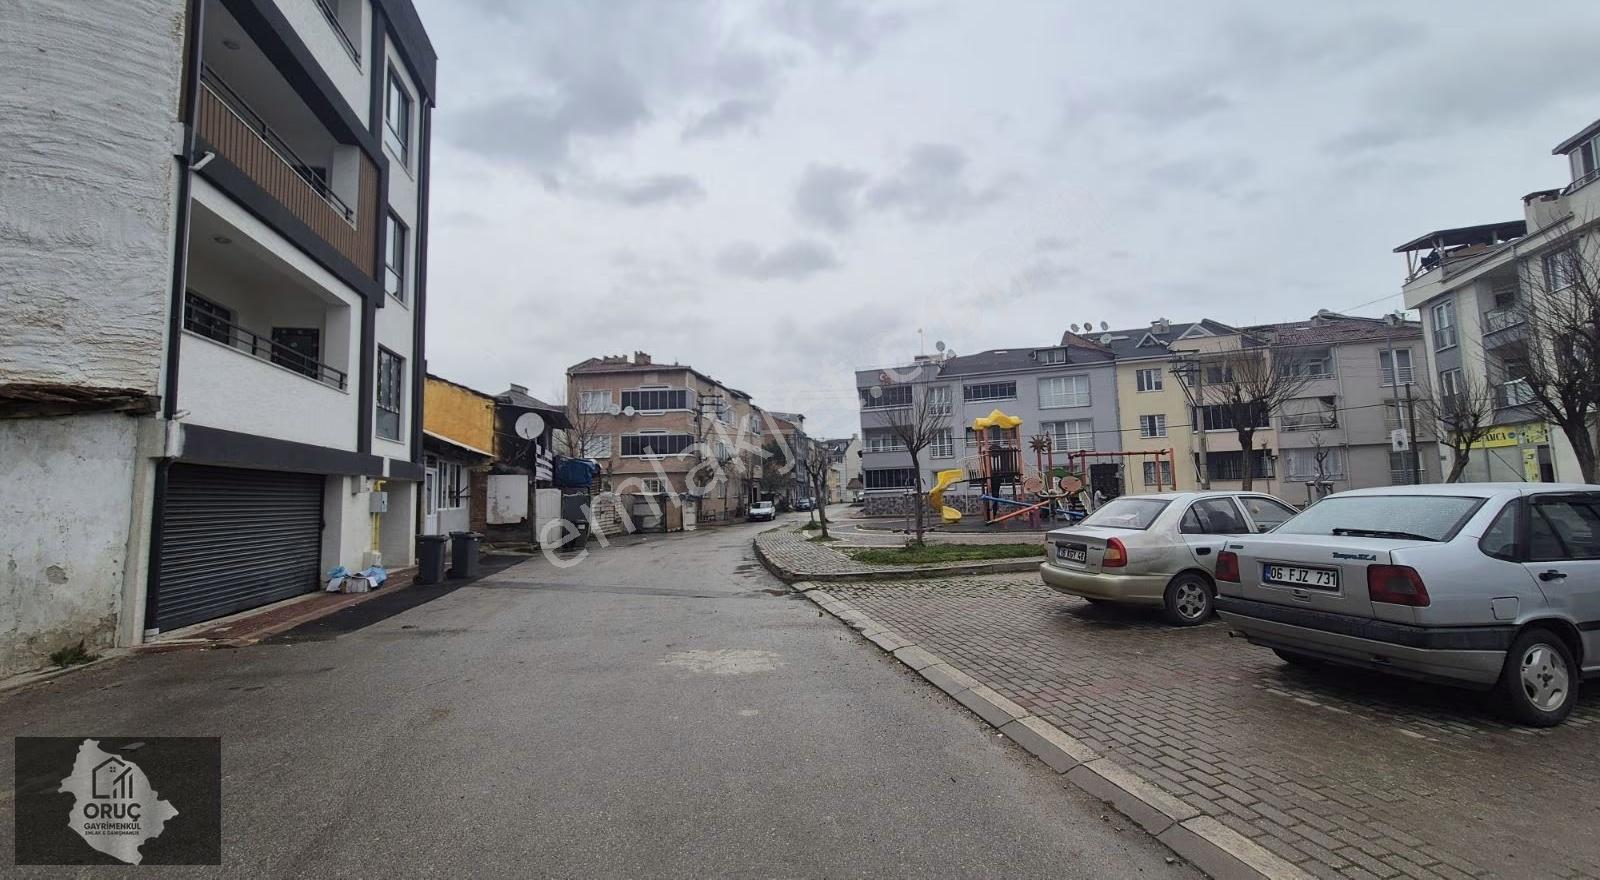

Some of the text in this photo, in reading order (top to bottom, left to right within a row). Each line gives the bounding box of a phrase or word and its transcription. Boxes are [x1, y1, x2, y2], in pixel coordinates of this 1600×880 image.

[1271, 567, 1337, 586] 06 FJZ 731
